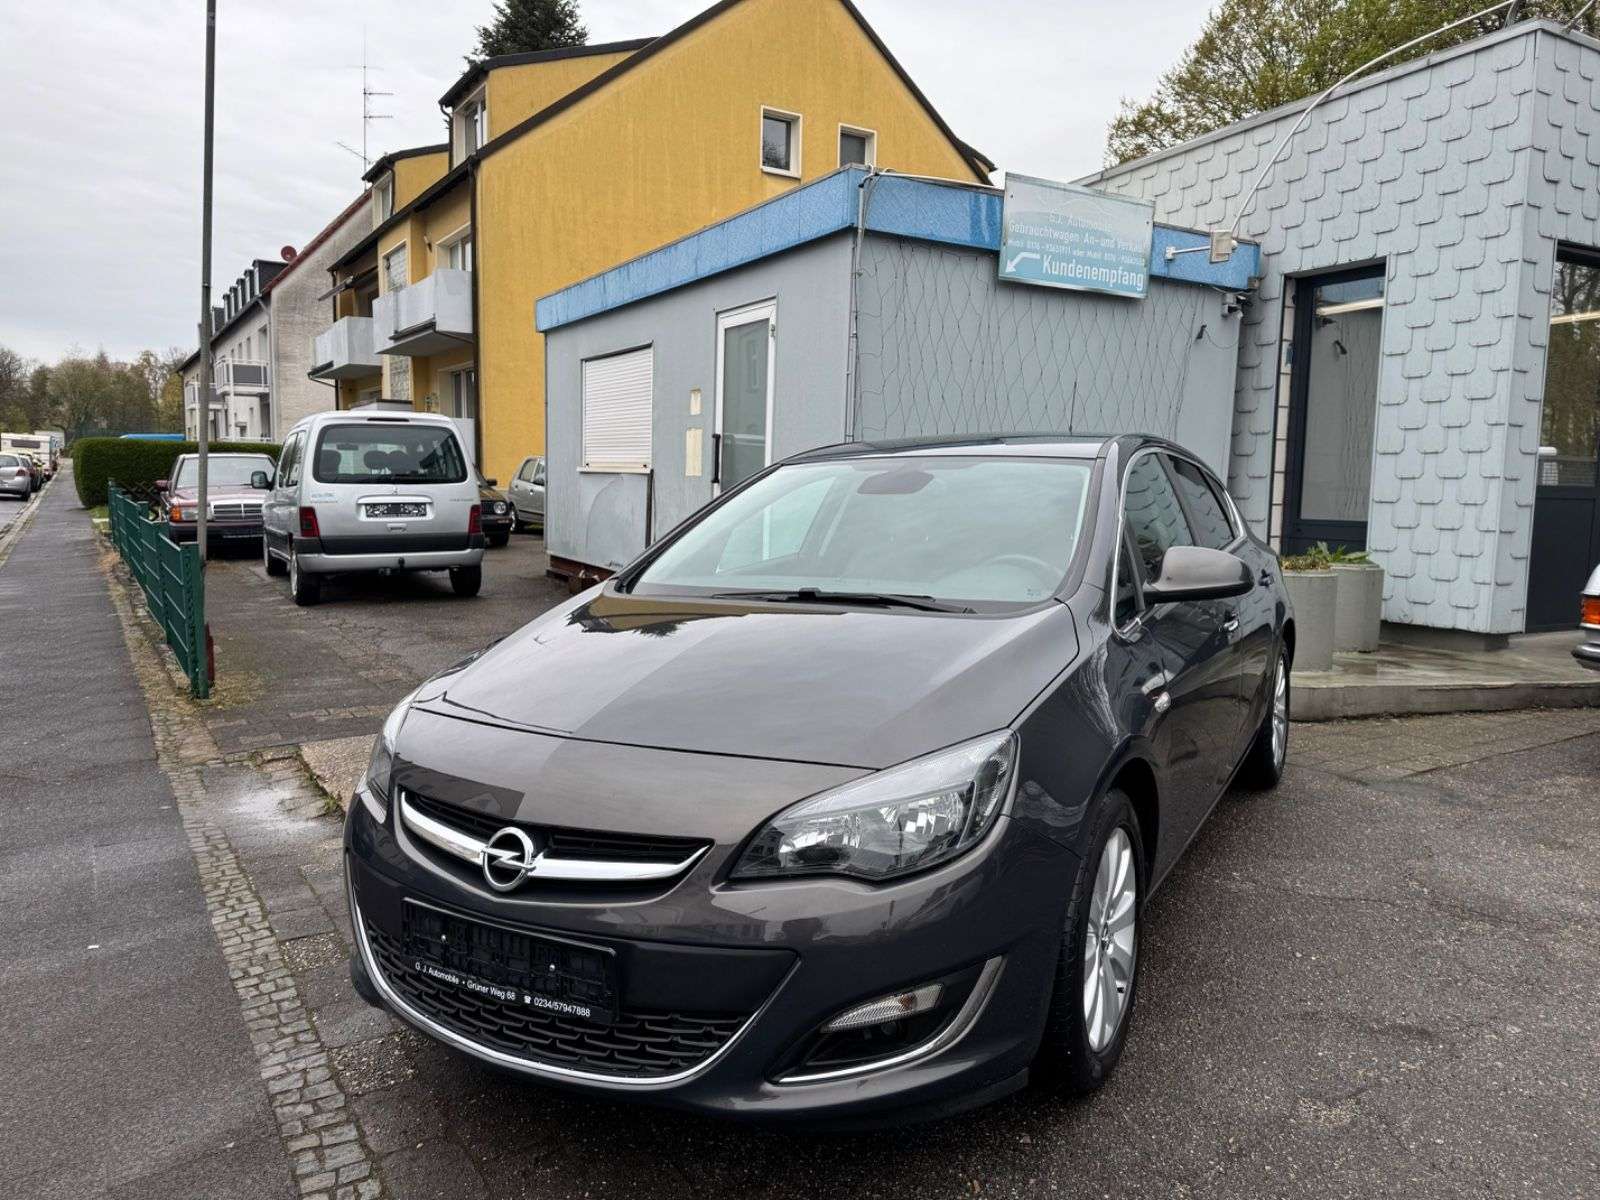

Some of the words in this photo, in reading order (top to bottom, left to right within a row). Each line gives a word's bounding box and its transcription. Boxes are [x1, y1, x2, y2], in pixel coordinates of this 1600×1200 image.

[1009, 220, 1080, 243] Gebrauchtwagen
[1043, 254, 1144, 291] Kundenempfang
[428, 967, 460, 985] Automobile
[490, 986, 506, 1001] Weg
